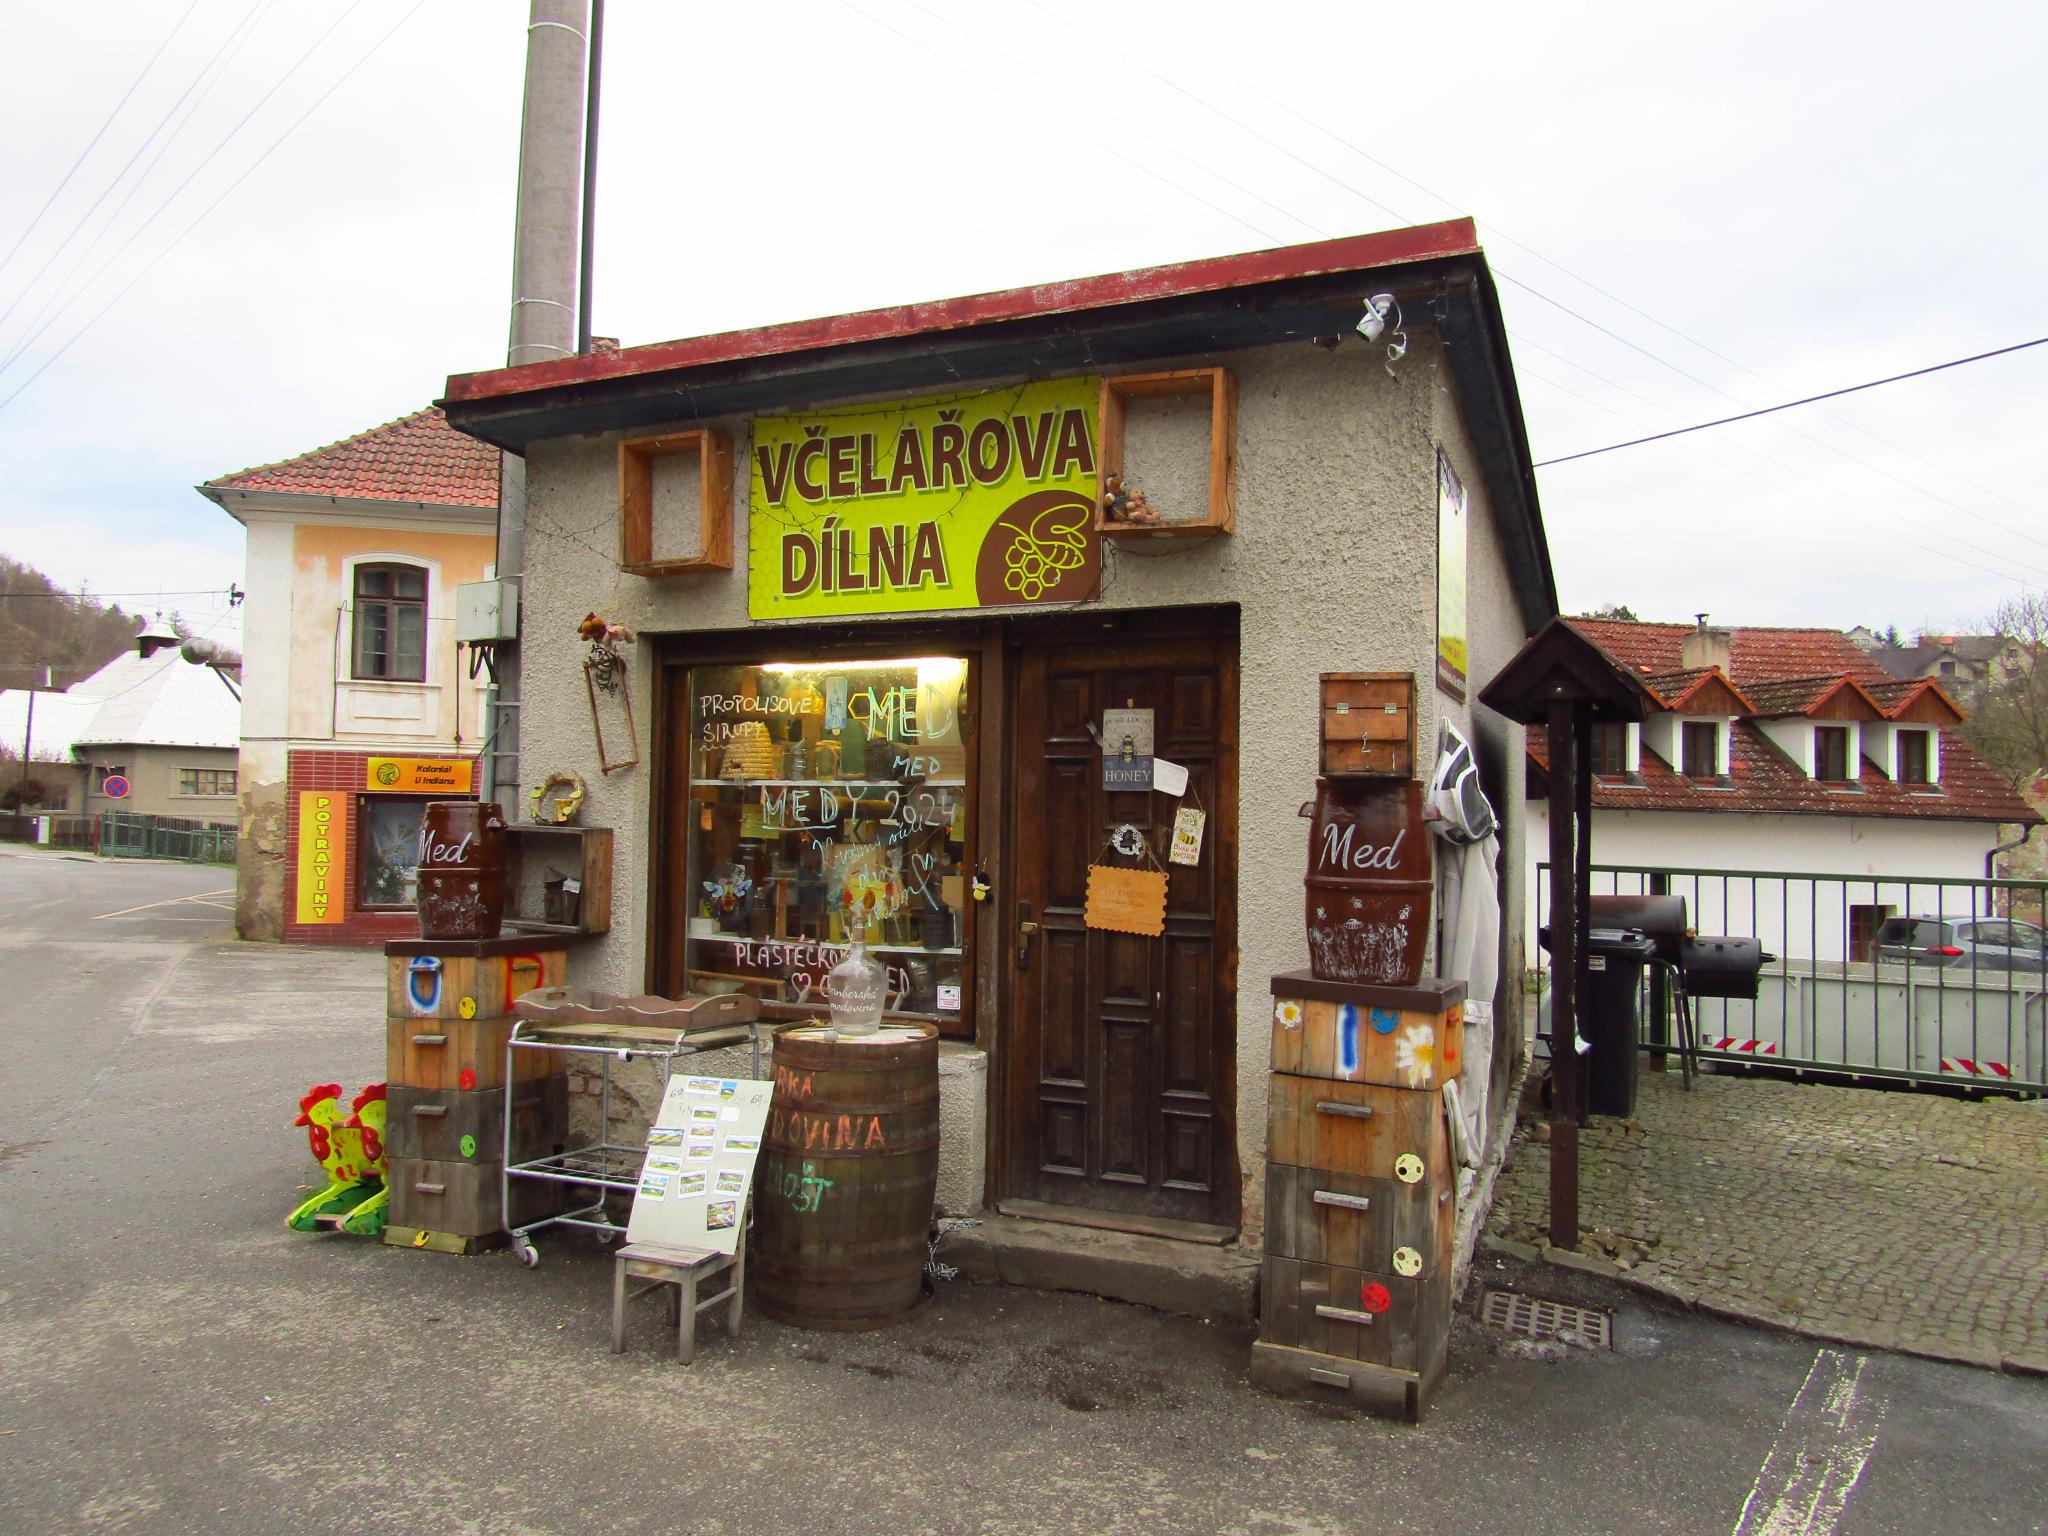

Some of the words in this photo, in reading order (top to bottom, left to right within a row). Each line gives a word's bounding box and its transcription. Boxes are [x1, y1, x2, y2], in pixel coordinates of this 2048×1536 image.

[757, 408, 1097, 506] VČELAŘOVA
[782, 515, 951, 596] DÍLNA
[866, 683, 952, 741] MED
[892, 755, 940, 778] MED
[1104, 770, 1151, 782] HONEY
[879, 788, 957, 827] 2024
[314, 797, 332, 919] POTRAVINY
[418, 829, 473, 864] Med
[1318, 822, 1406, 871] Med
